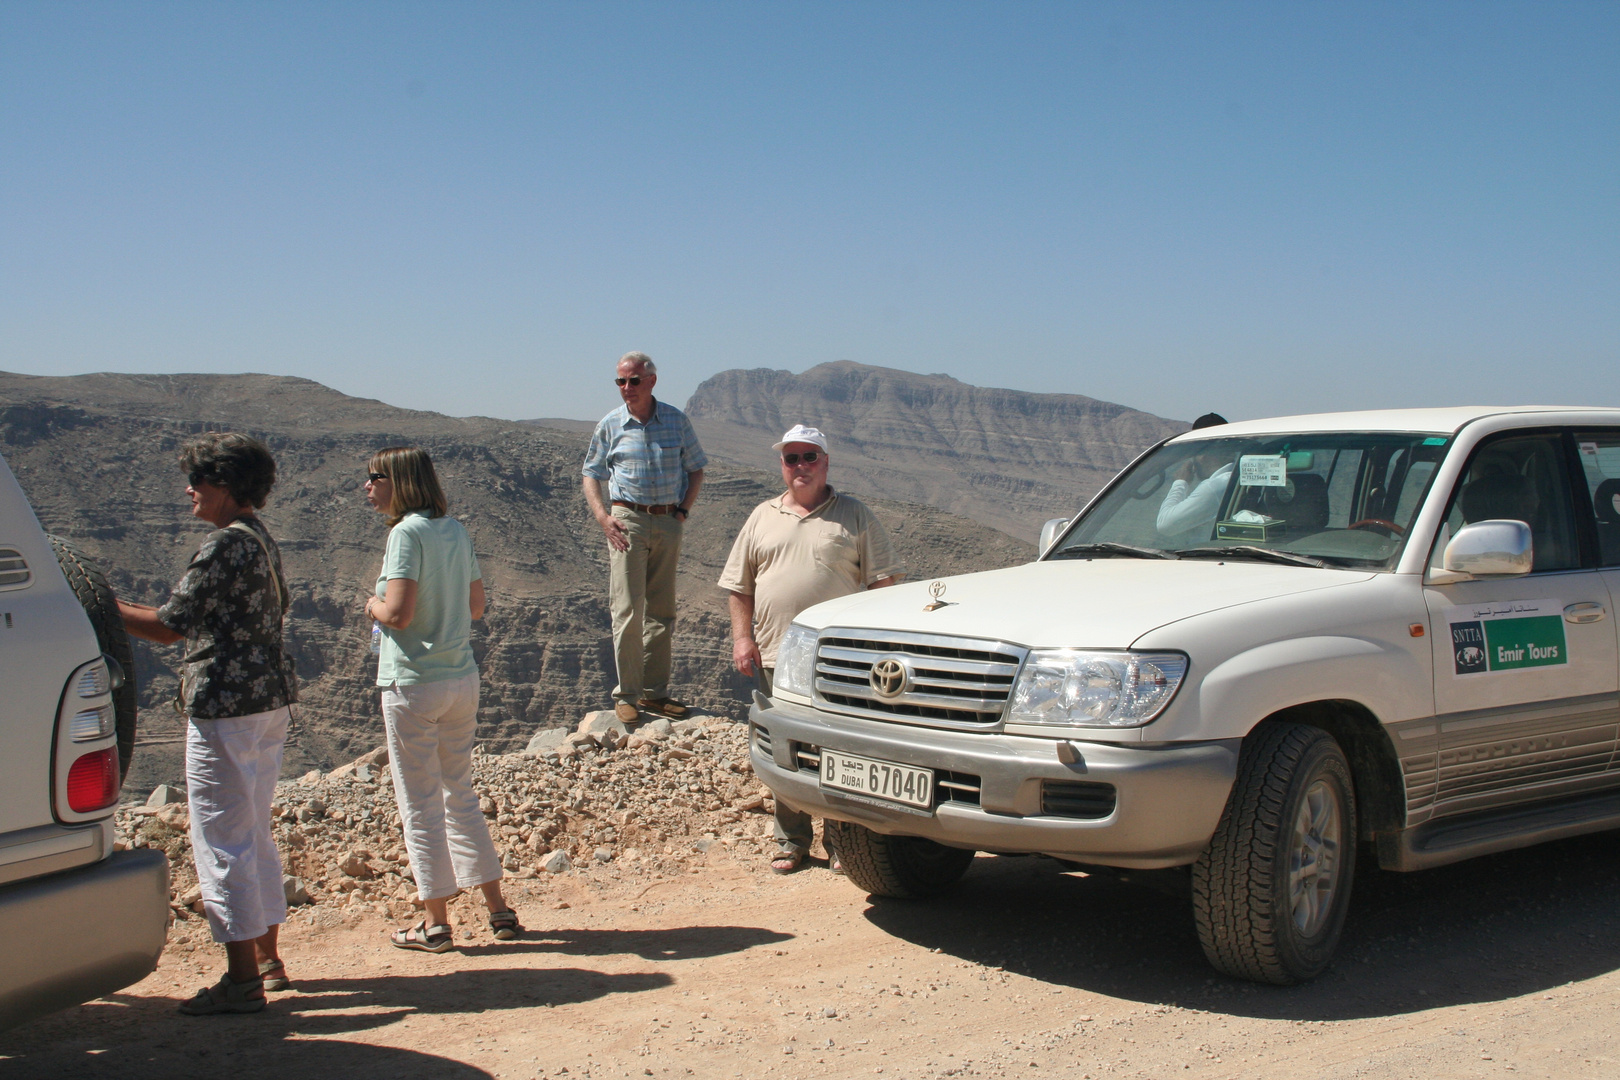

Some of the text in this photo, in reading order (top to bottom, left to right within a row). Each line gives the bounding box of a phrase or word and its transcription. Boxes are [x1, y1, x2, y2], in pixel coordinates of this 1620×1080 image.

[1453, 628, 1482, 643] SNTTA
[1497, 643, 1558, 663] Emir Tours
[826, 755, 835, 781] B
[869, 763, 928, 802] 67040
[841, 774, 864, 789] DUBAI
